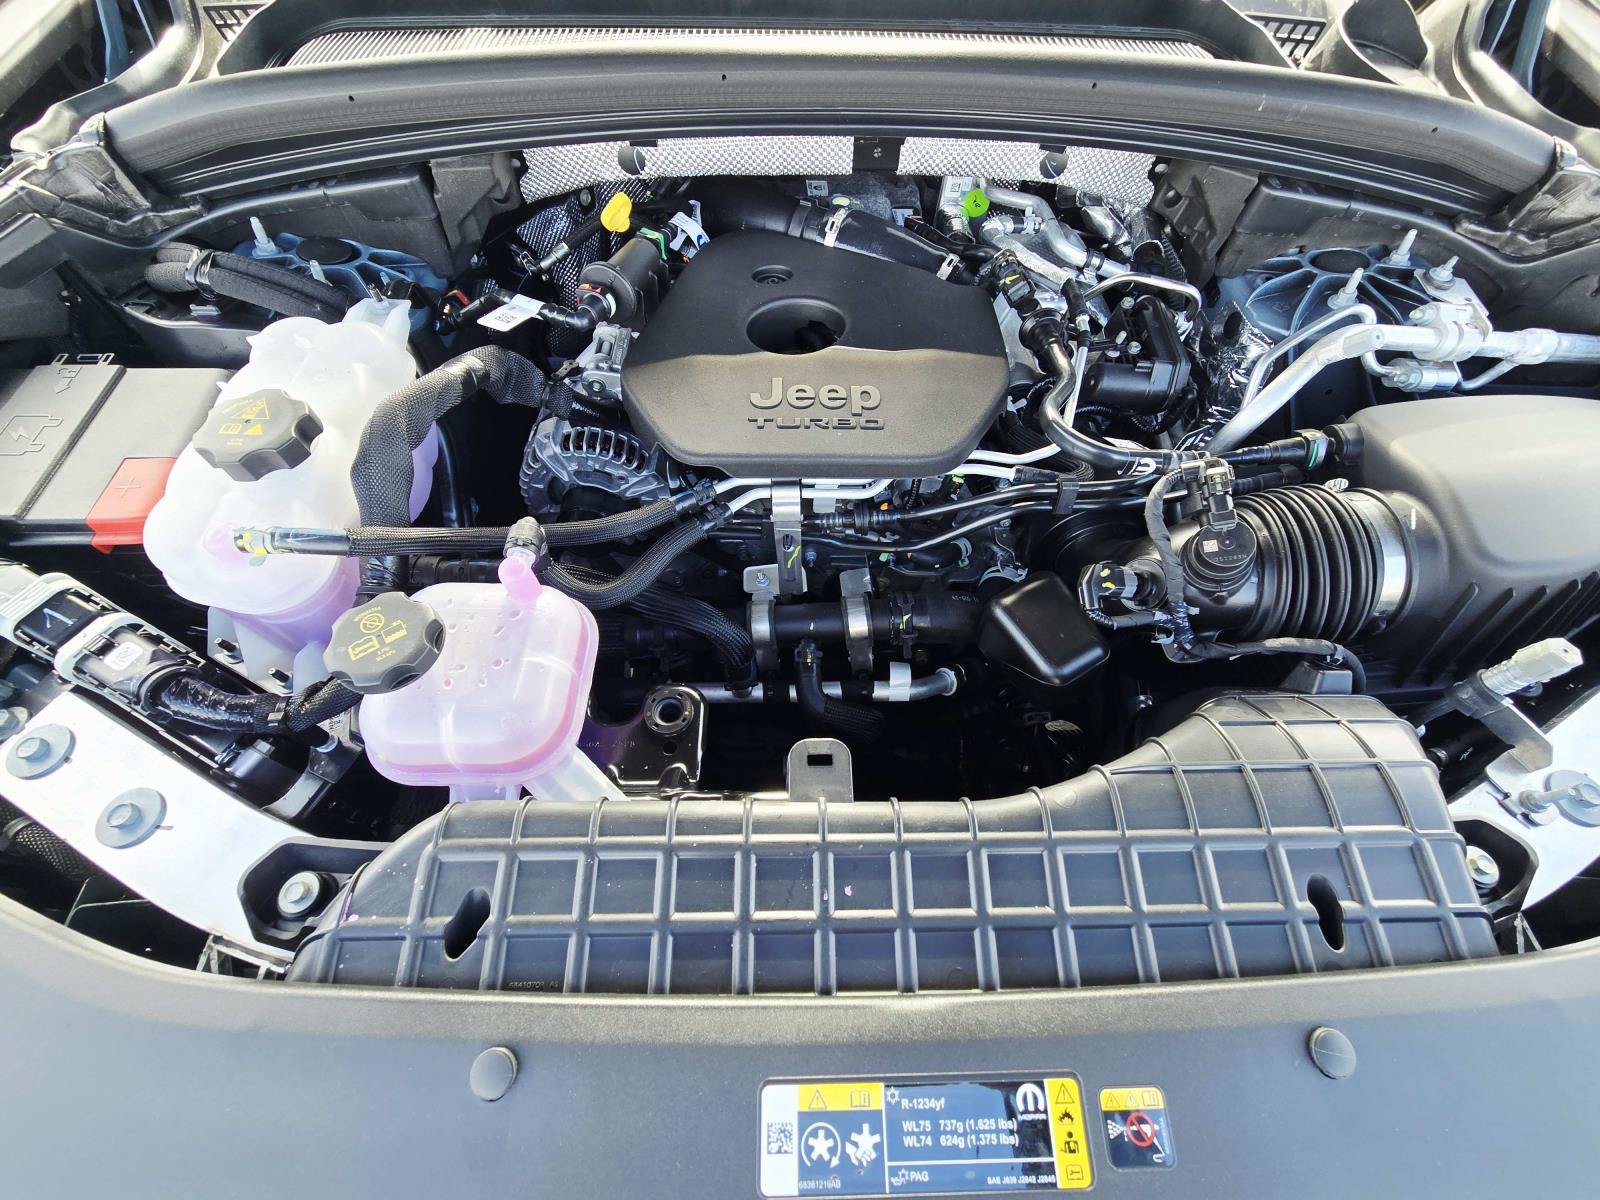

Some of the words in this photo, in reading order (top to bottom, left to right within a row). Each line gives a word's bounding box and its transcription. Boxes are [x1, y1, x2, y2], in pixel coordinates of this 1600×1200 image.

[750, 377, 881, 416] Jeep
[748, 417, 885, 430] TURBO
[901, 1098, 945, 1111] R-1234yf
[902, 1120, 931, 1132] WL75
[939, 1120, 963, 1133] 737g
[966, 1119, 996, 1132] (1.625
[998, 1118, 1018, 1131] lbs)
[903, 1135, 932, 1147] WL74
[940, 1135, 965, 1148] 624g
[967, 1134, 997, 1147] (1.375
[1000, 1133, 1019, 1146] lbs)
[910, 1171, 929, 1182] PAG
